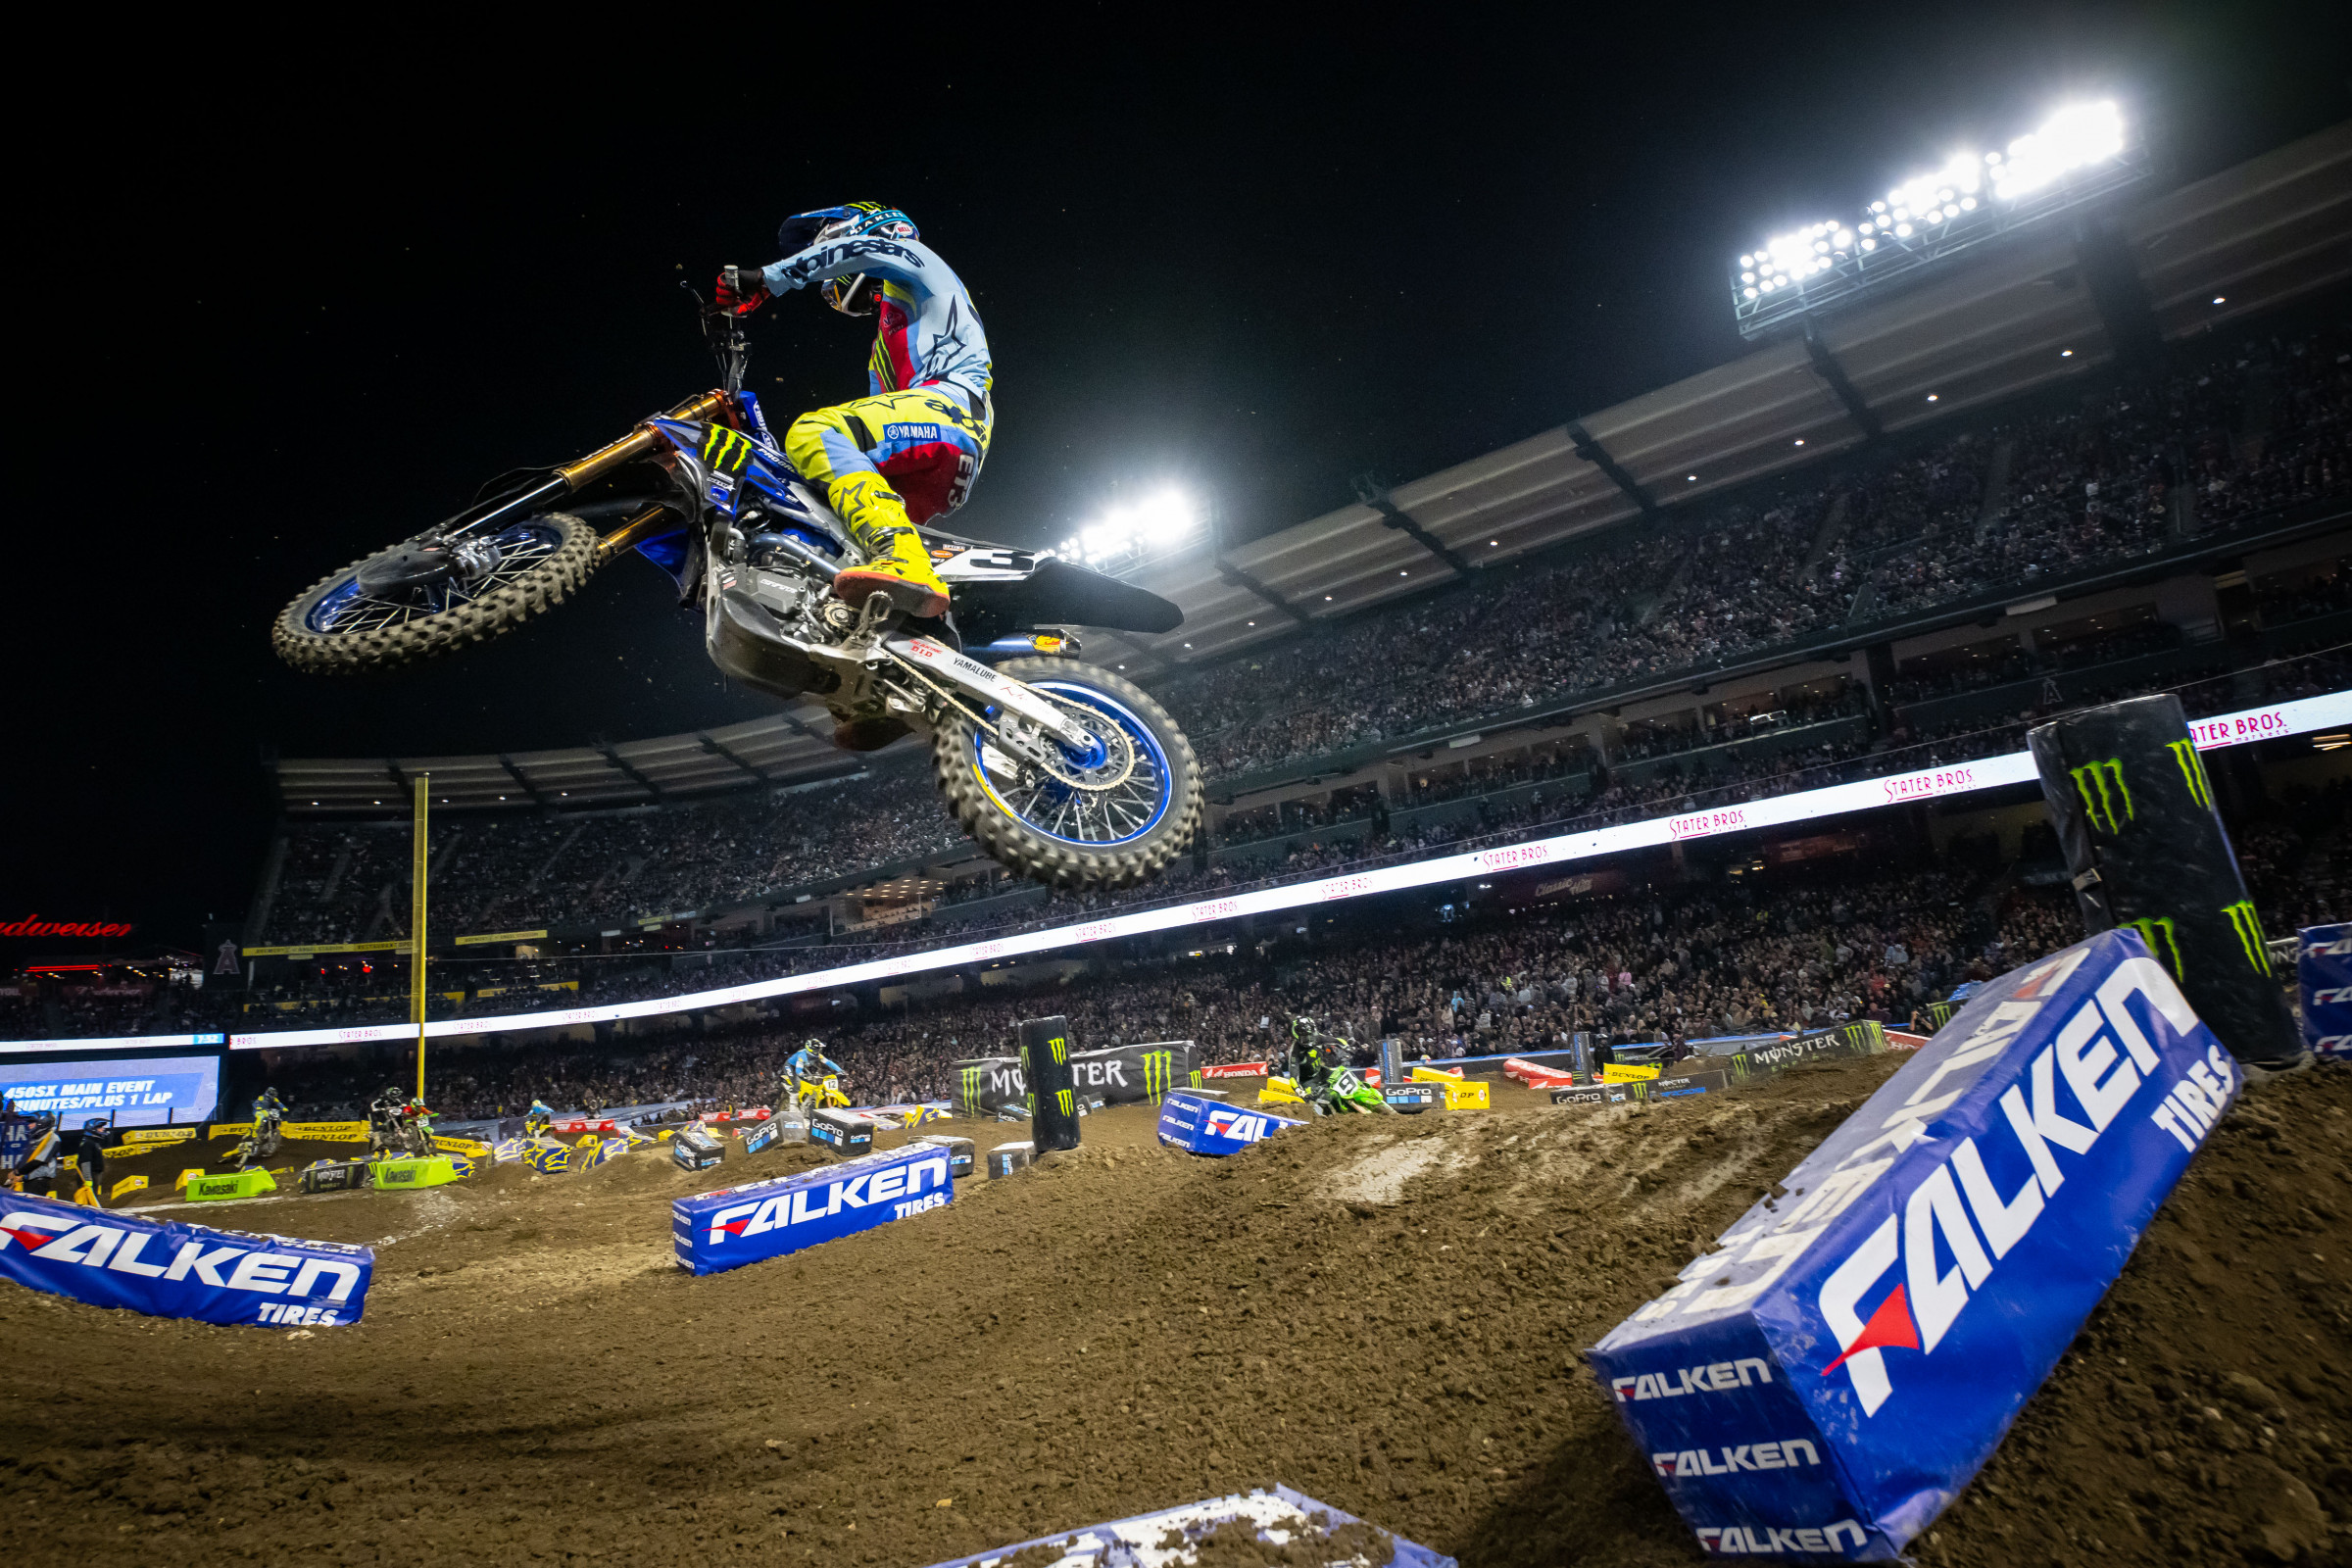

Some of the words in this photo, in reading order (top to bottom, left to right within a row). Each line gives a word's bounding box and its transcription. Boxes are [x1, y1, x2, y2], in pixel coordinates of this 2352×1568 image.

[897, 224, 910, 233] BELL
[900, 424, 938, 439] YAMAHA
[948, 454, 974, 511] ET3
[969, 551, 1036, 570] 3
[953, 657, 998, 683] YAMALUBE
[2234, 711, 2287, 735] BROS.
[1884, 776, 1932, 803] STATER
[1669, 816, 1710, 841] STATER
[1483, 852, 1518, 872] STATER
[1192, 904, 1216, 922] STATER
[1753, 1032, 1841, 1065] MONSTER
[990, 1057, 1128, 1098] MOTER
[1224, 1069, 1259, 1078] HONDA
[1611, 1071, 1650, 1080] DUNLOP
[4, 1084, 59, 1099] 450SX
[60, 1082, 105, 1097] MAIN
[106, 1080, 156, 1094] EVENT
[827, 1079, 837, 1090] 12
[1386, 1087, 1432, 1097] GoPro
[129, 1094, 138, 1104] 1
[143, 1092, 173, 1104] LAP
[1166, 1097, 1199, 1114] FALKEN
[1555, 1092, 1602, 1105] GoPro
[2151, 1044, 2235, 1153] TIRES
[812, 1117, 844, 1137] GoPro
[1161, 1114, 1195, 1131] FALKEN
[301, 1133, 358, 1142] DUNLOP
[746, 1122, 777, 1146] GoPro
[1158, 1131, 1191, 1149] FALKEN
[384, 1164, 418, 1185] Kawasaki
[197, 1179, 240, 1197] Kawasaki
[1821, 956, 2201, 1418] FALKEN
[701, 1156, 948, 1246] FALKEN
[894, 1191, 946, 1220] TIRES
[257, 1301, 339, 1328] TIRES
[1611, 1356, 1774, 1403] FALKEN
[1652, 1438, 1822, 1478] FALKEN
[1695, 1518, 1868, 1554] FALKEN
